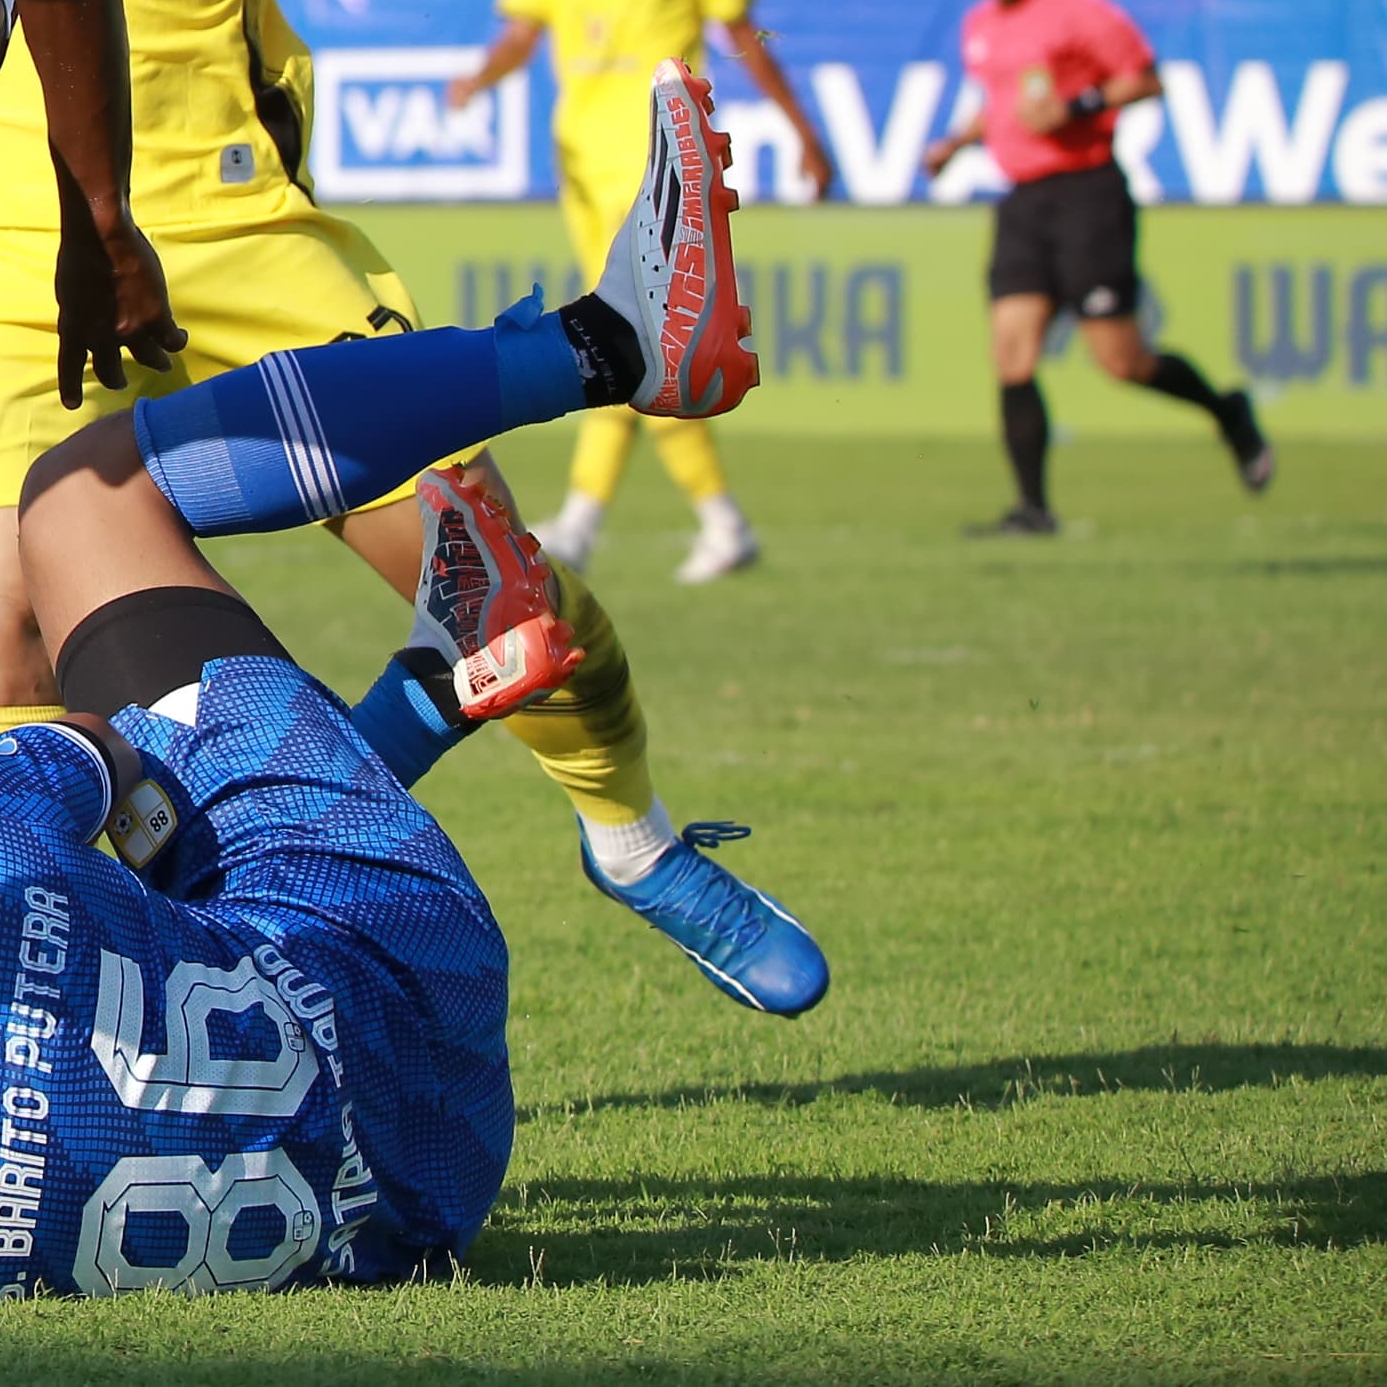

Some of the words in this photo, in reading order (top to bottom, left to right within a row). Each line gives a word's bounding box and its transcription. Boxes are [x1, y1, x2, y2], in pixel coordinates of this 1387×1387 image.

[344, 84, 497, 161] VAR
[149, 809, 169, 833] 88
[5, 885, 70, 1074] PUTERA
[72, 947, 321, 1296] 86
